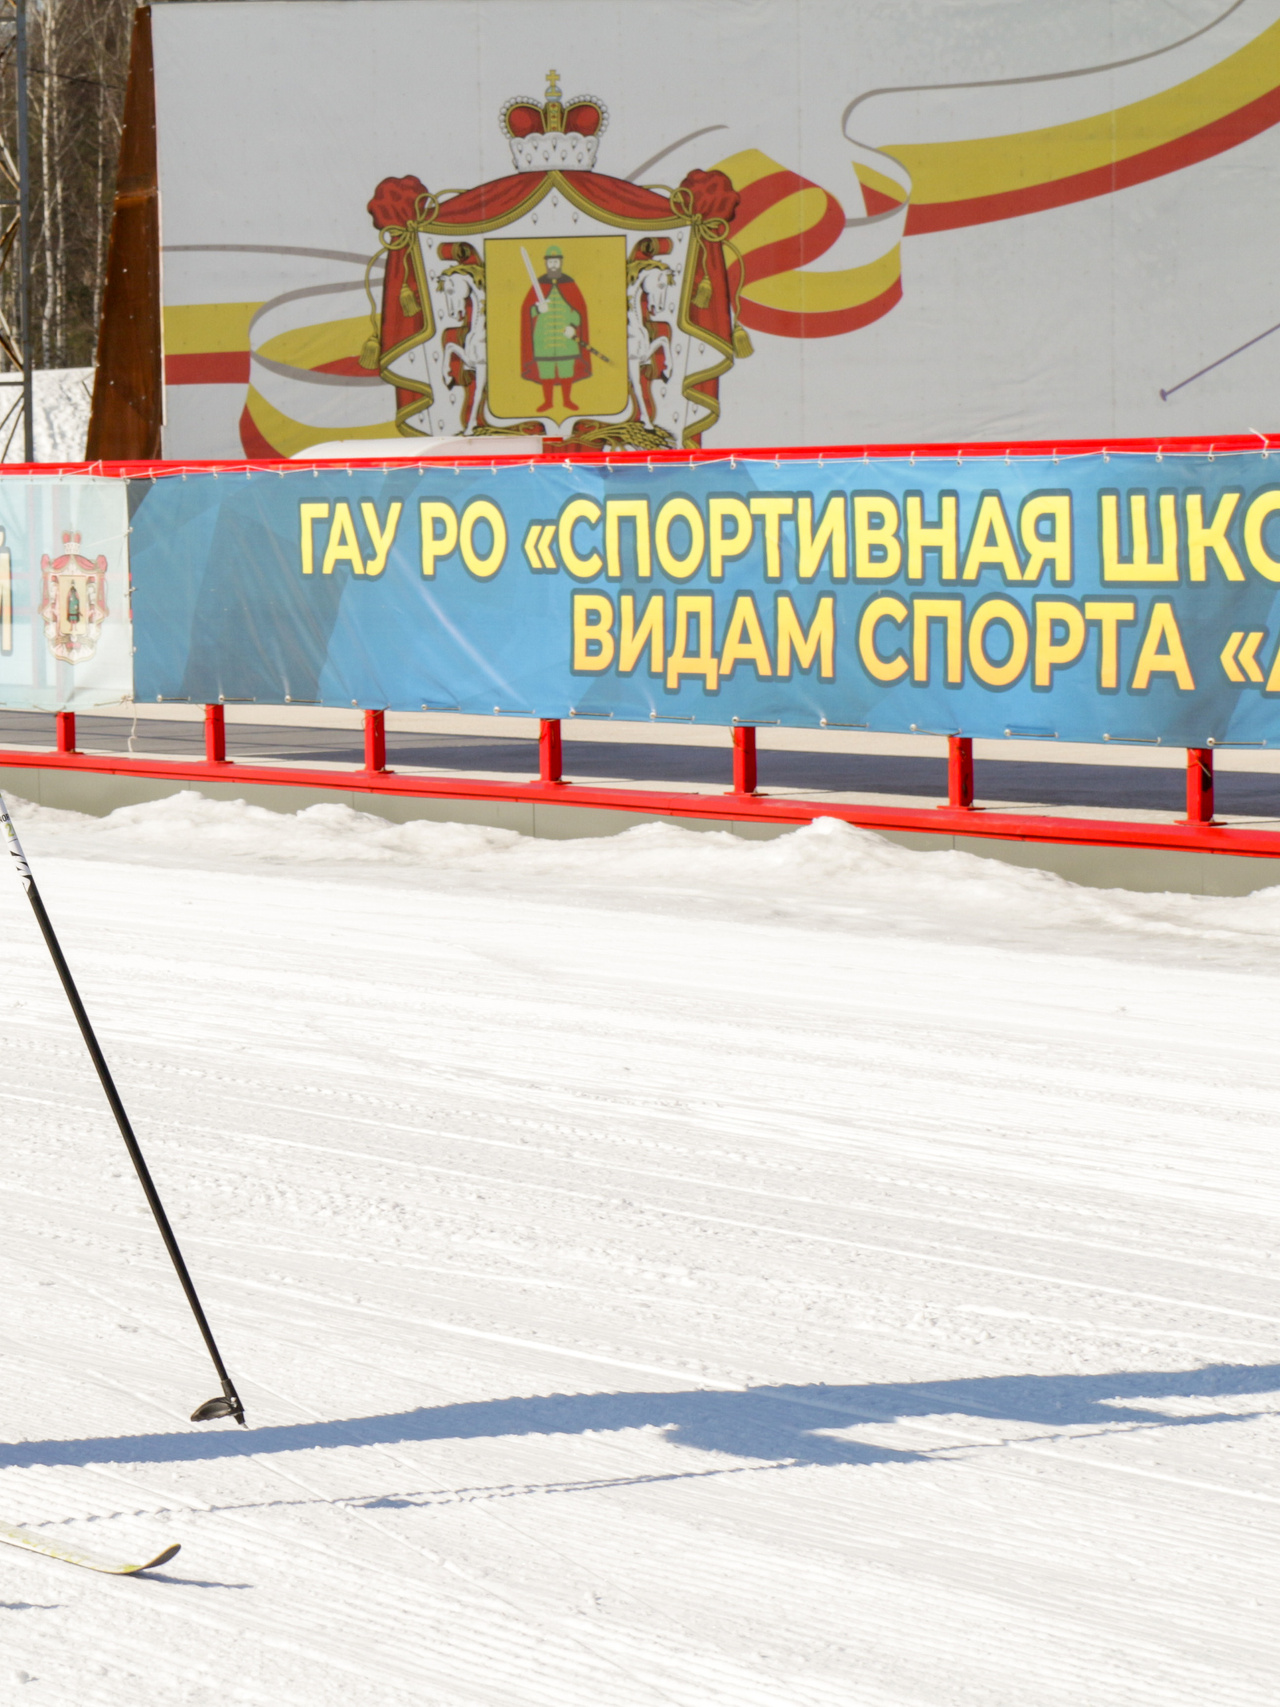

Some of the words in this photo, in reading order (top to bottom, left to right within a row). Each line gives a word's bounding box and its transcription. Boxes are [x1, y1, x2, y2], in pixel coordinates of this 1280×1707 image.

[301, 502, 403, 576] ГАУ
[421, 500, 507, 578] РО
[524, 494, 1072, 583] «СПОРТИВНАЯ
[573, 594, 835, 691] ВИДАМ
[858, 595, 1196, 691] СПОРТА
